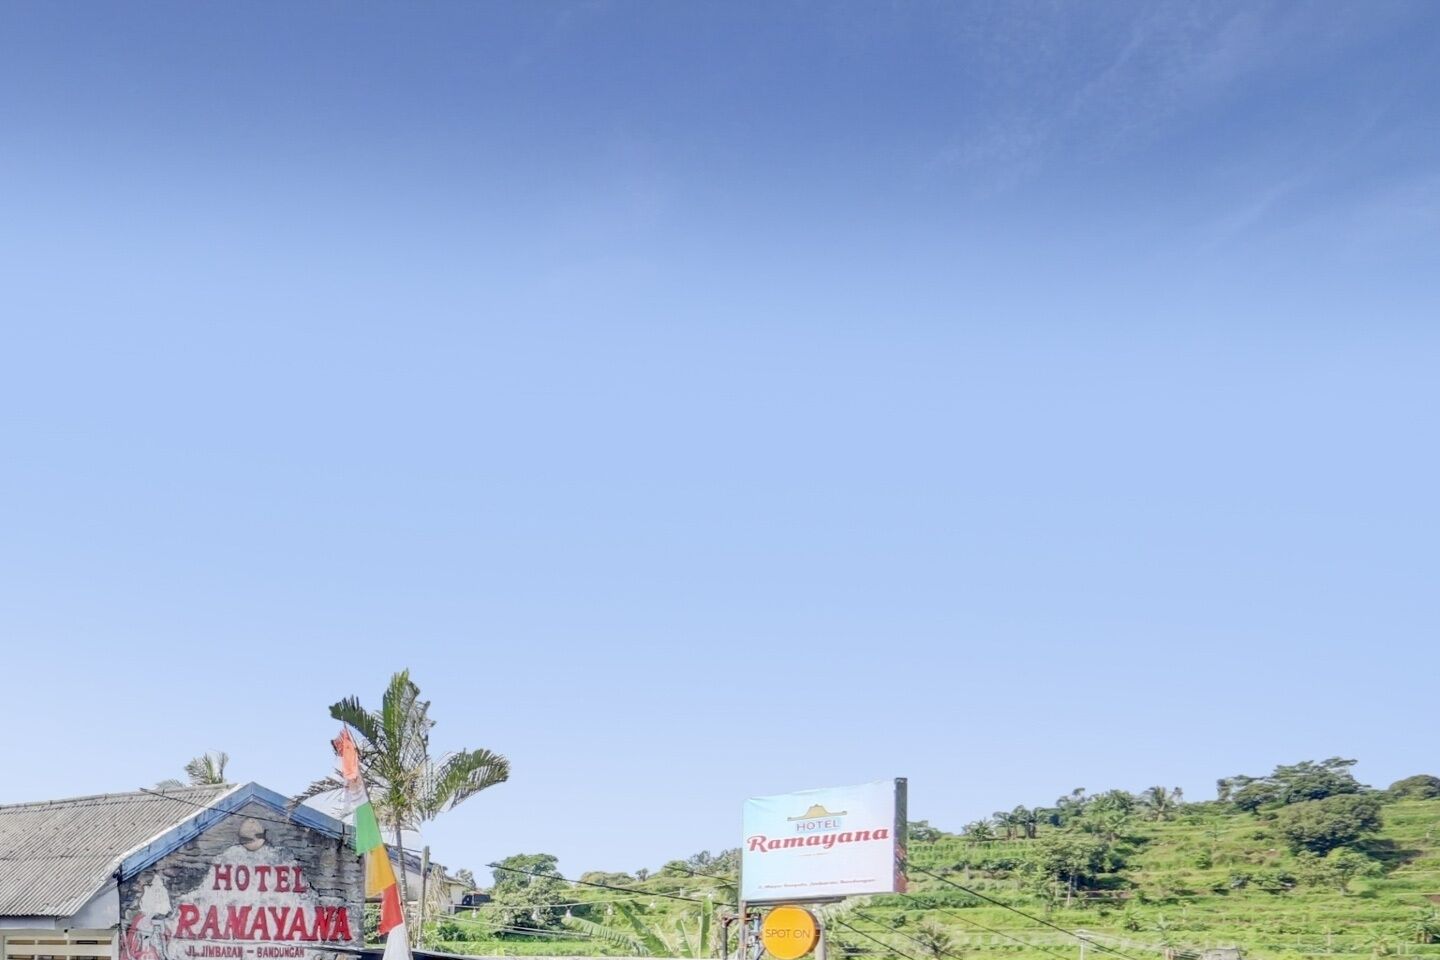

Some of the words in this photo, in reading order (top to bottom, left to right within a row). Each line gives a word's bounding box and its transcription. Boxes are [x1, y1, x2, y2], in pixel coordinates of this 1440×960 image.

[796, 820, 840, 831] HOTEL
[747, 828, 889, 853] Ramayana
[212, 864, 310, 893] HOTEL
[173, 903, 353, 941] RAMAYANA
[765, 928, 791, 938] SPOT
[793, 928, 810, 939] ON
[257, 946, 305, 958] BANDUNGAN
